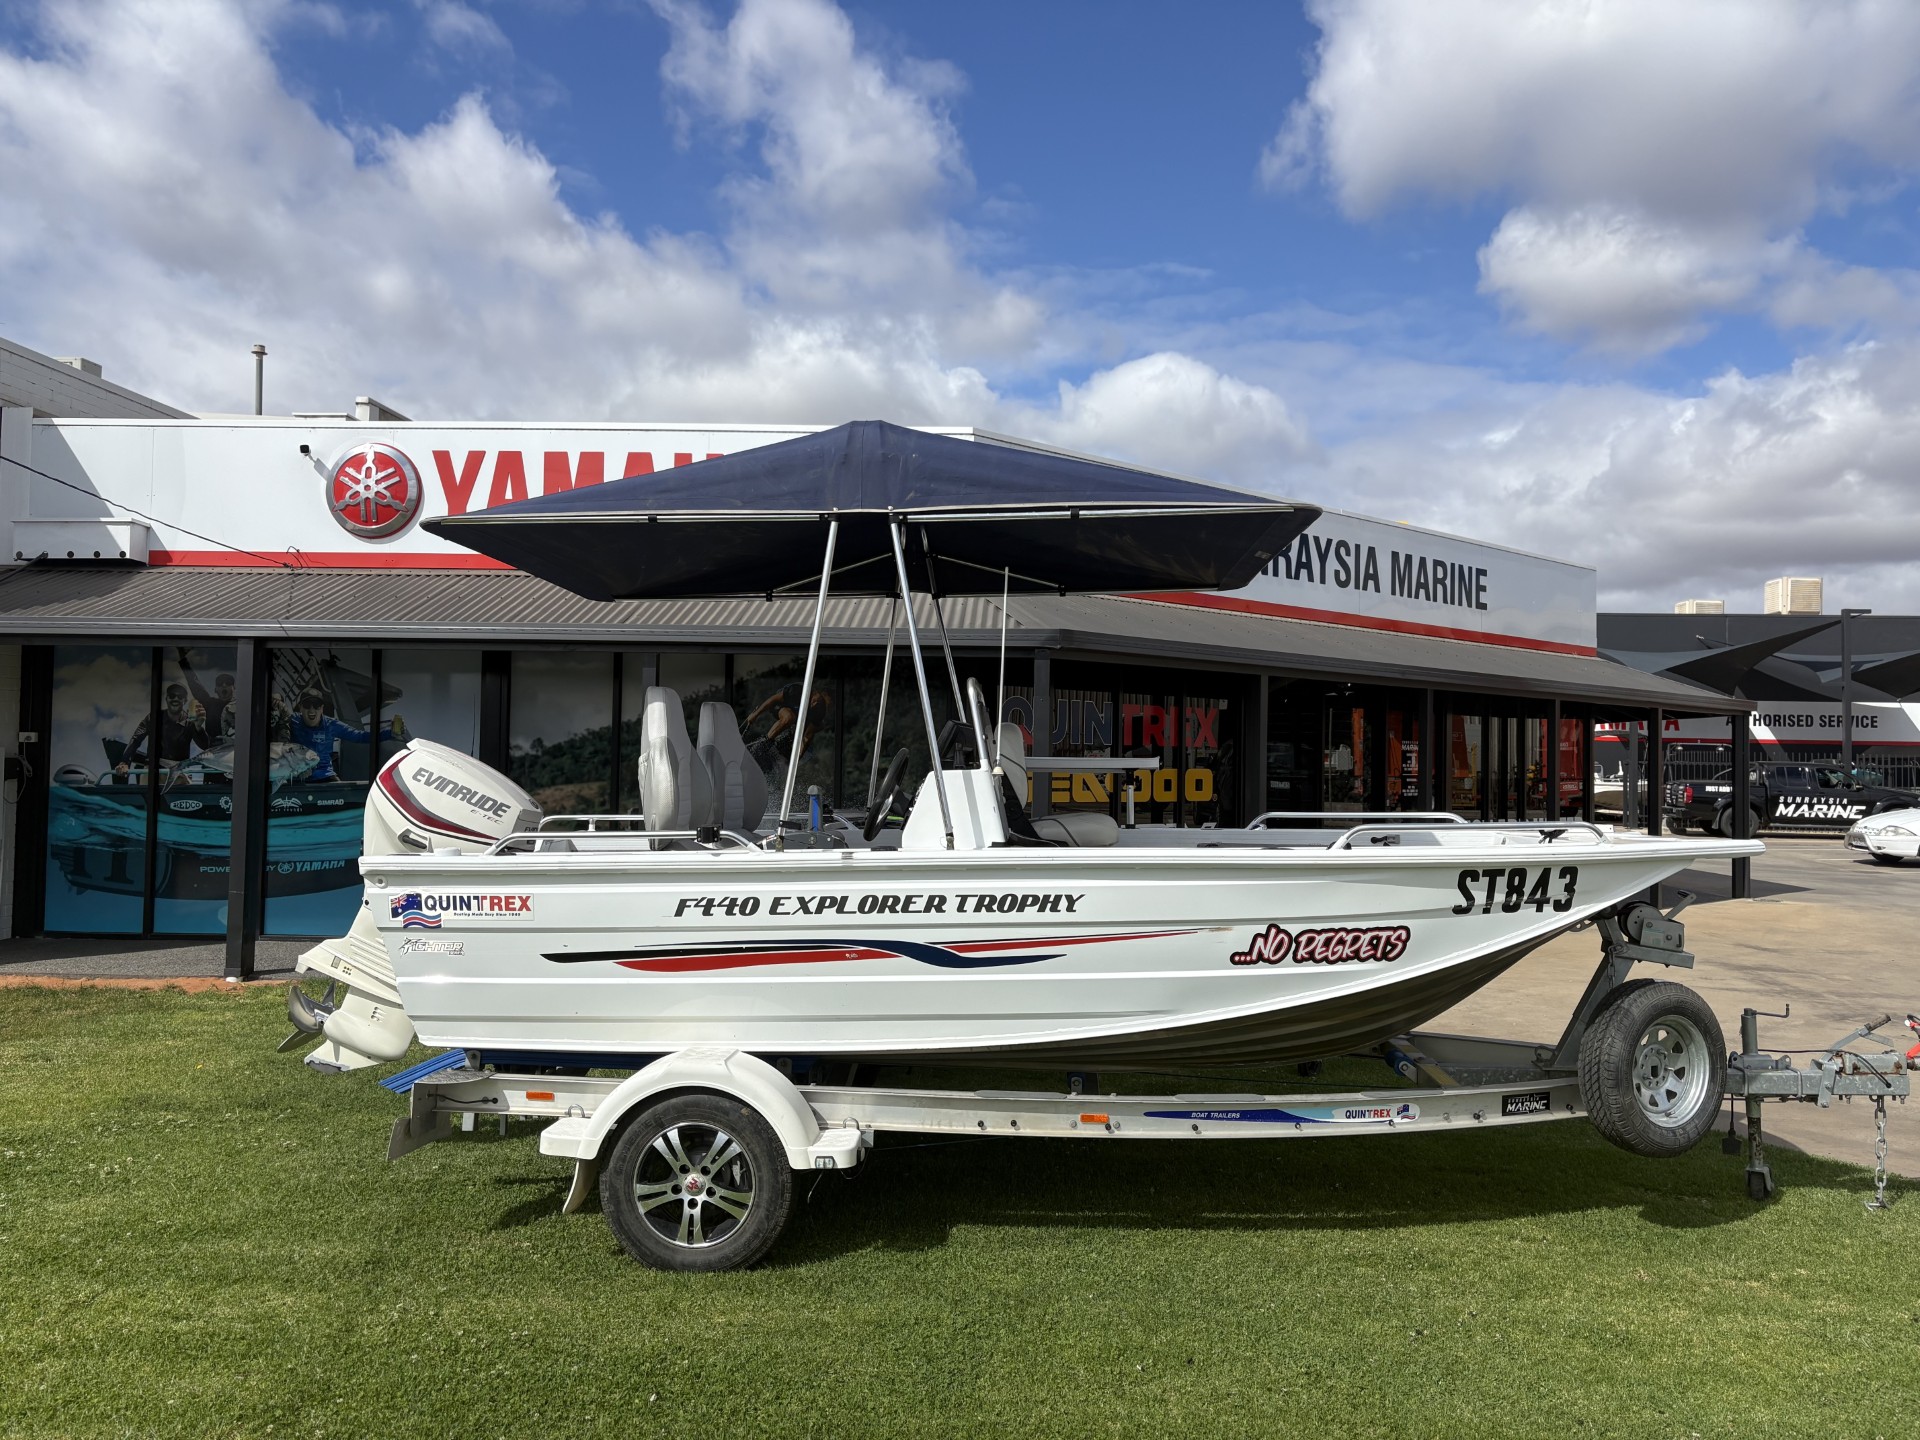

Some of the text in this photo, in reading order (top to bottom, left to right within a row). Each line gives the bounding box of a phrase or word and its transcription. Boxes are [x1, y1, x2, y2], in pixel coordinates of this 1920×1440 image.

[1261, 532, 1487, 611] RAYSIA MARINE
[1726, 714, 1878, 728] AHORISED SERICE
[412, 767, 512, 818] EVINRUDE
[1779, 796, 1848, 805] SUNRAYSIA
[470, 809, 505, 825] E-TEC
[1775, 804, 1867, 819] MARINE
[296, 860, 345, 872] YAMAHA
[1452, 866, 1579, 915] ST843
[424, 895, 532, 912] QUINTREX
[674, 893, 1086, 917] F440 EXPLORER TROPHY
[1295, 927, 1410, 963] REGRETS
[1345, 1108, 1391, 1119] QUINTREX
[1506, 1100, 1547, 1112] MARINE
